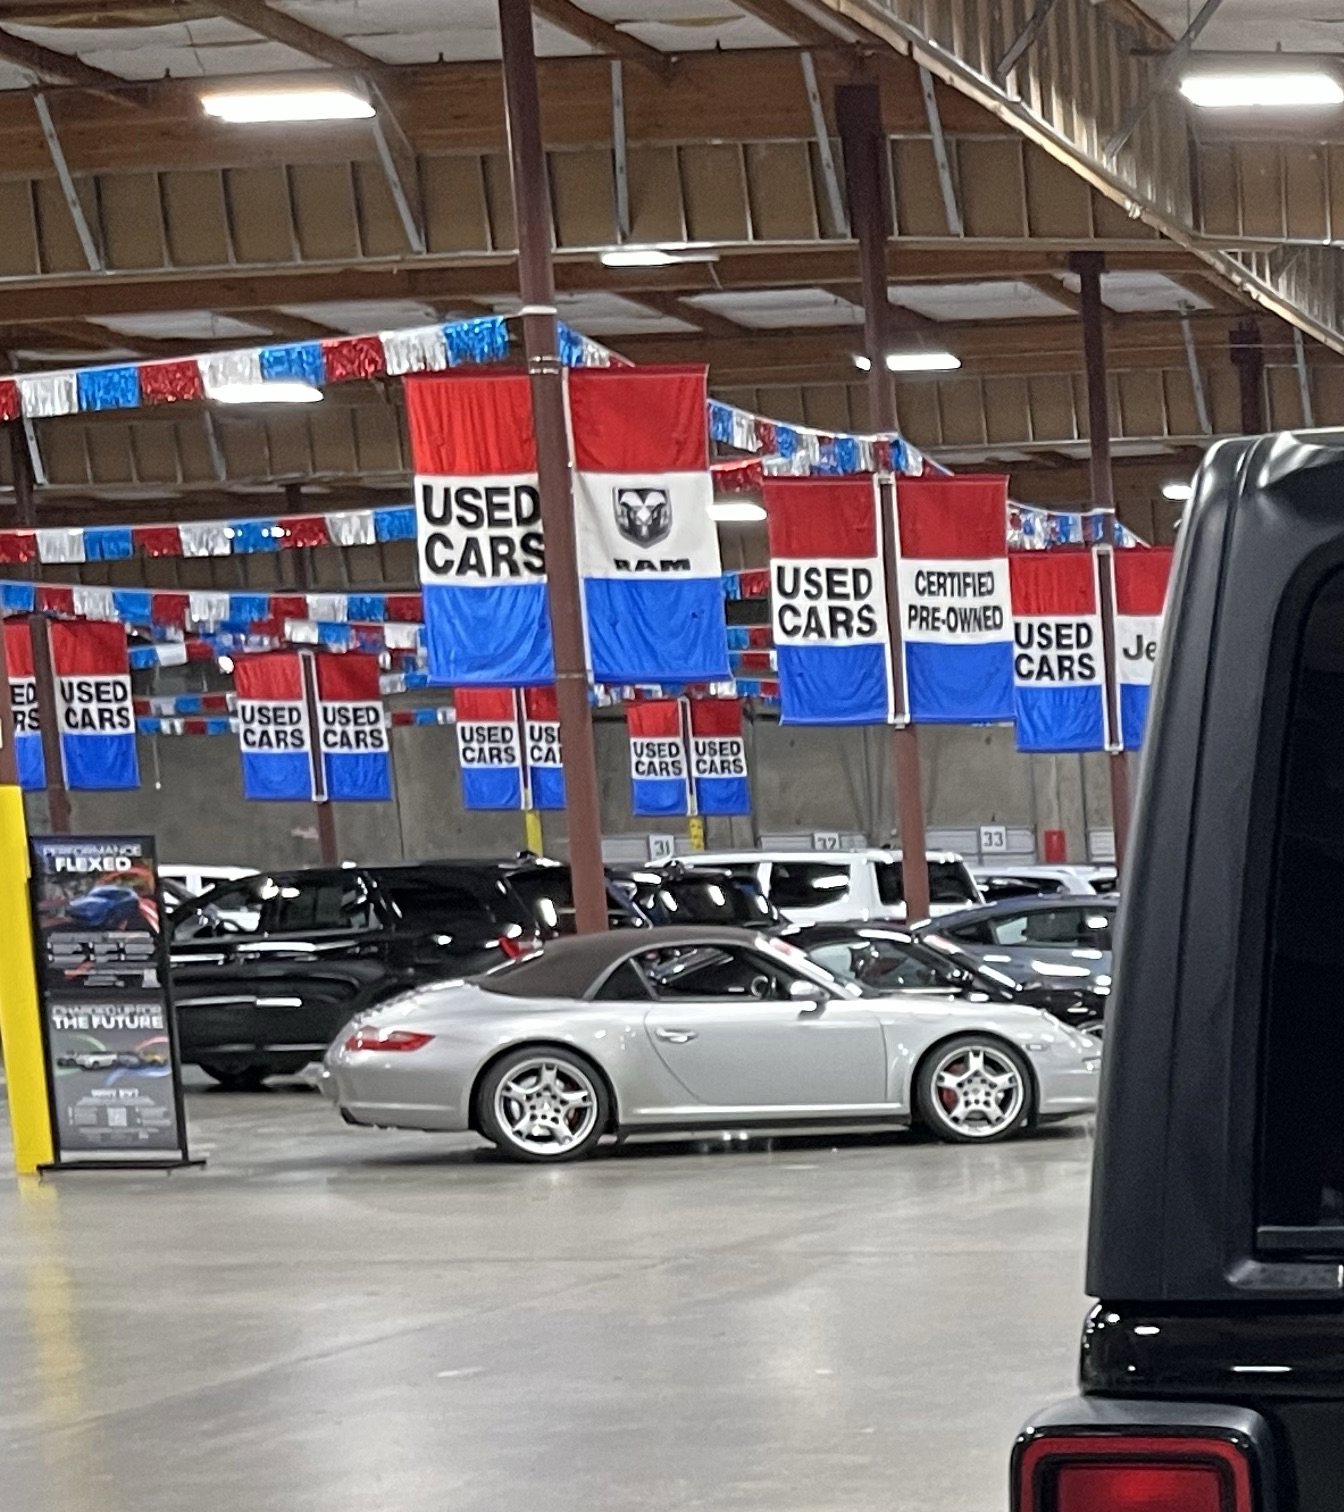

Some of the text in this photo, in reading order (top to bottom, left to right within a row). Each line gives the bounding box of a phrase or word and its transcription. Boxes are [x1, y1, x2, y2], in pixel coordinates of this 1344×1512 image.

[422, 484, 540, 529] USED
[424, 532, 545, 577] CARS
[613, 558, 691, 572] RAM
[776, 566, 873, 600] USED
[914, 570, 995, 597] CERTIFIED
[778, 604, 878, 638] CARS
[908, 605, 1004, 634] PRE-OWNED
[1014, 622, 1093, 650] USED
[1123, 634, 1157, 663] Je
[1014, 653, 1096, 681] CARS
[9, 683, 36, 705] ED
[60, 681, 128, 704] USED
[13, 708, 40, 731] RS
[64, 707, 131, 730] CARS
[241, 705, 302, 726] USED
[322, 707, 380, 726] USED
[243, 729, 305, 749] CARS
[323, 729, 384, 749] CARS
[460, 726, 514, 744] USED
[530, 725, 561, 744] US
[462, 746, 517, 764] CARS
[531, 745, 562, 763] CA
[634, 742, 680, 758] USED
[695, 740, 741, 757] USED
[635, 760, 683, 776] CARS
[695, 759, 744, 775] CARS
[983, 831, 1004, 847] 33
[55, 857, 132, 872] FLEXED
[52, 1016, 164, 1030] THE FUTURE
